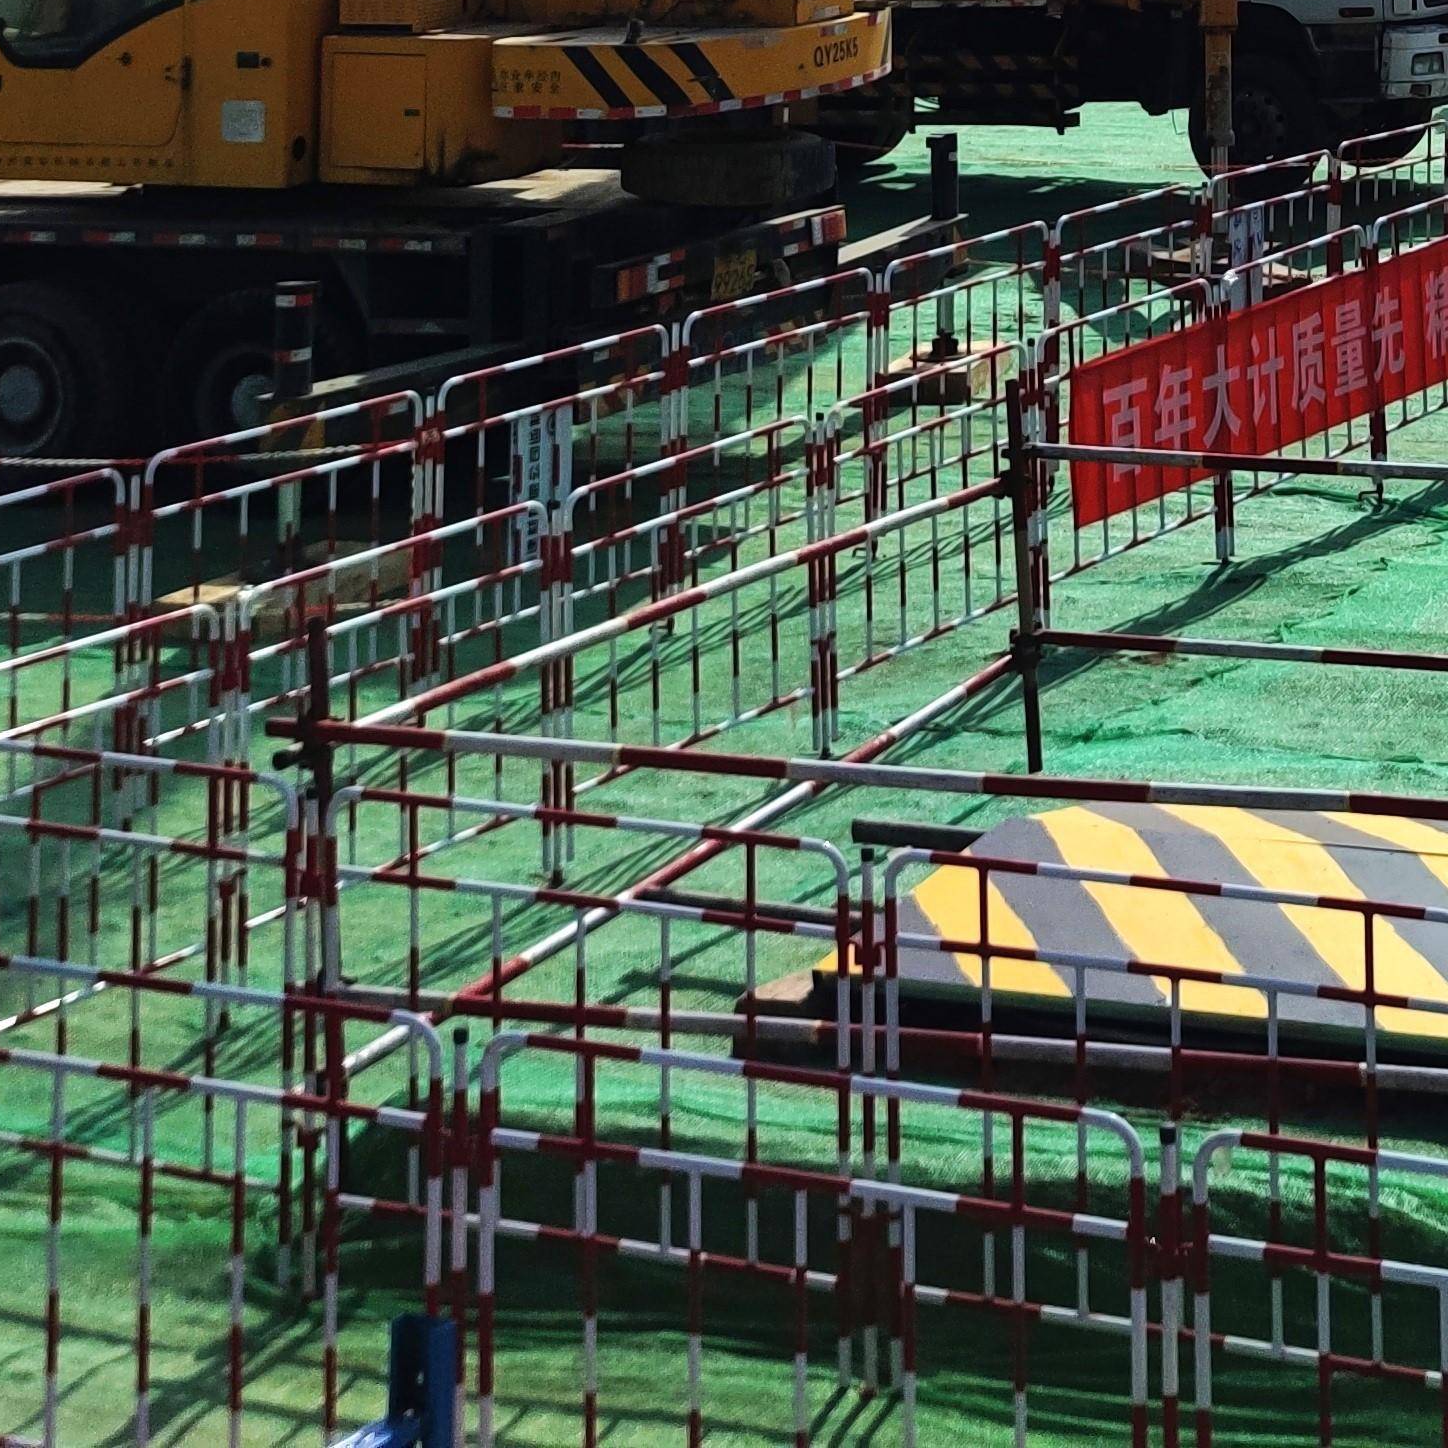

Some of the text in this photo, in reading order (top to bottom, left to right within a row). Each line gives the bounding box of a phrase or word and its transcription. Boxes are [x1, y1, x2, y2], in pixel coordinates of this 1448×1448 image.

[813, 35, 860, 69] QY25K5
[1103, 290, 1406, 484] 百年大计质量先
